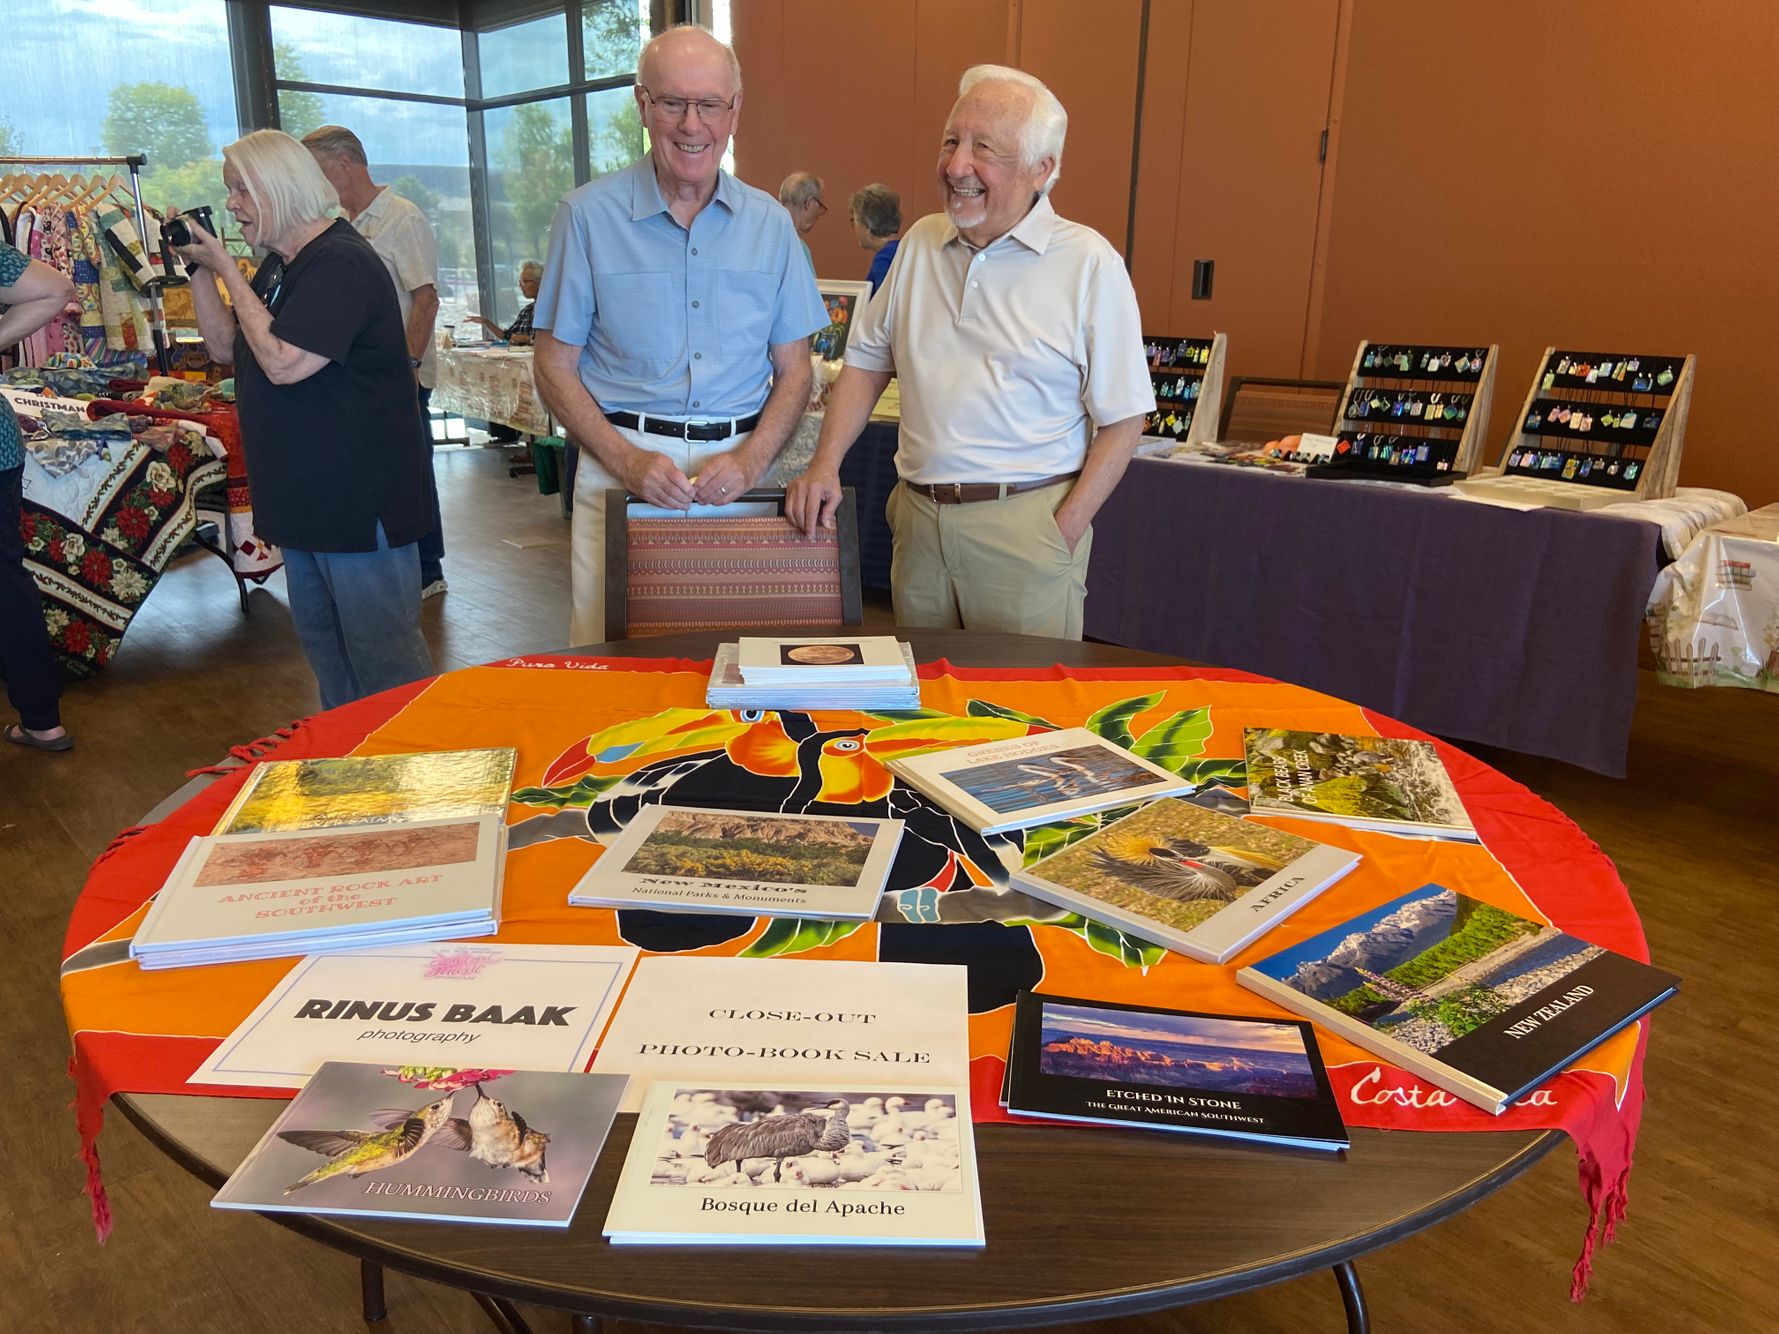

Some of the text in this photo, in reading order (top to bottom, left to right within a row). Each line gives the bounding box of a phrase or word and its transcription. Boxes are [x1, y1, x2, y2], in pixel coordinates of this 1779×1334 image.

[14, 397, 86, 413] CHRISTMAN
[564, 660, 609, 671] Vida
[966, 753, 1002, 765] LAKE
[1292, 749, 1311, 771] CREEK
[1272, 756, 1294, 802] BLACK BEARS
[1301, 792, 1318, 805] OF
[218, 873, 445, 904] ANCIENT ROCK ART
[632, 886, 807, 905] National Parks & Monuments
[639, 877, 808, 895] New Mexico's
[1249, 876, 1305, 913] AFRICA
[254, 896, 398, 920] SOUTHWEST
[298, 893, 362, 906] of the
[293, 998, 579, 1027] RINUS BAAK
[708, 1008, 877, 1025] CLOSE-OUT
[1503, 984, 1595, 1040] NEW ZEALAND
[356, 1028, 482, 1045] photography
[638, 1043, 932, 1064] PHOTO-BOOK SALE
[1350, 1066, 1458, 1109] Costa
[1106, 1088, 1242, 1111] ETCHED IN STONE
[1085, 1100, 1266, 1125] THE GREAT AMERICAN SOUTHWEST
[363, 1181, 552, 1205] HUMMINGBIRDS
[699, 1197, 906, 1218] Bosque del Apache
